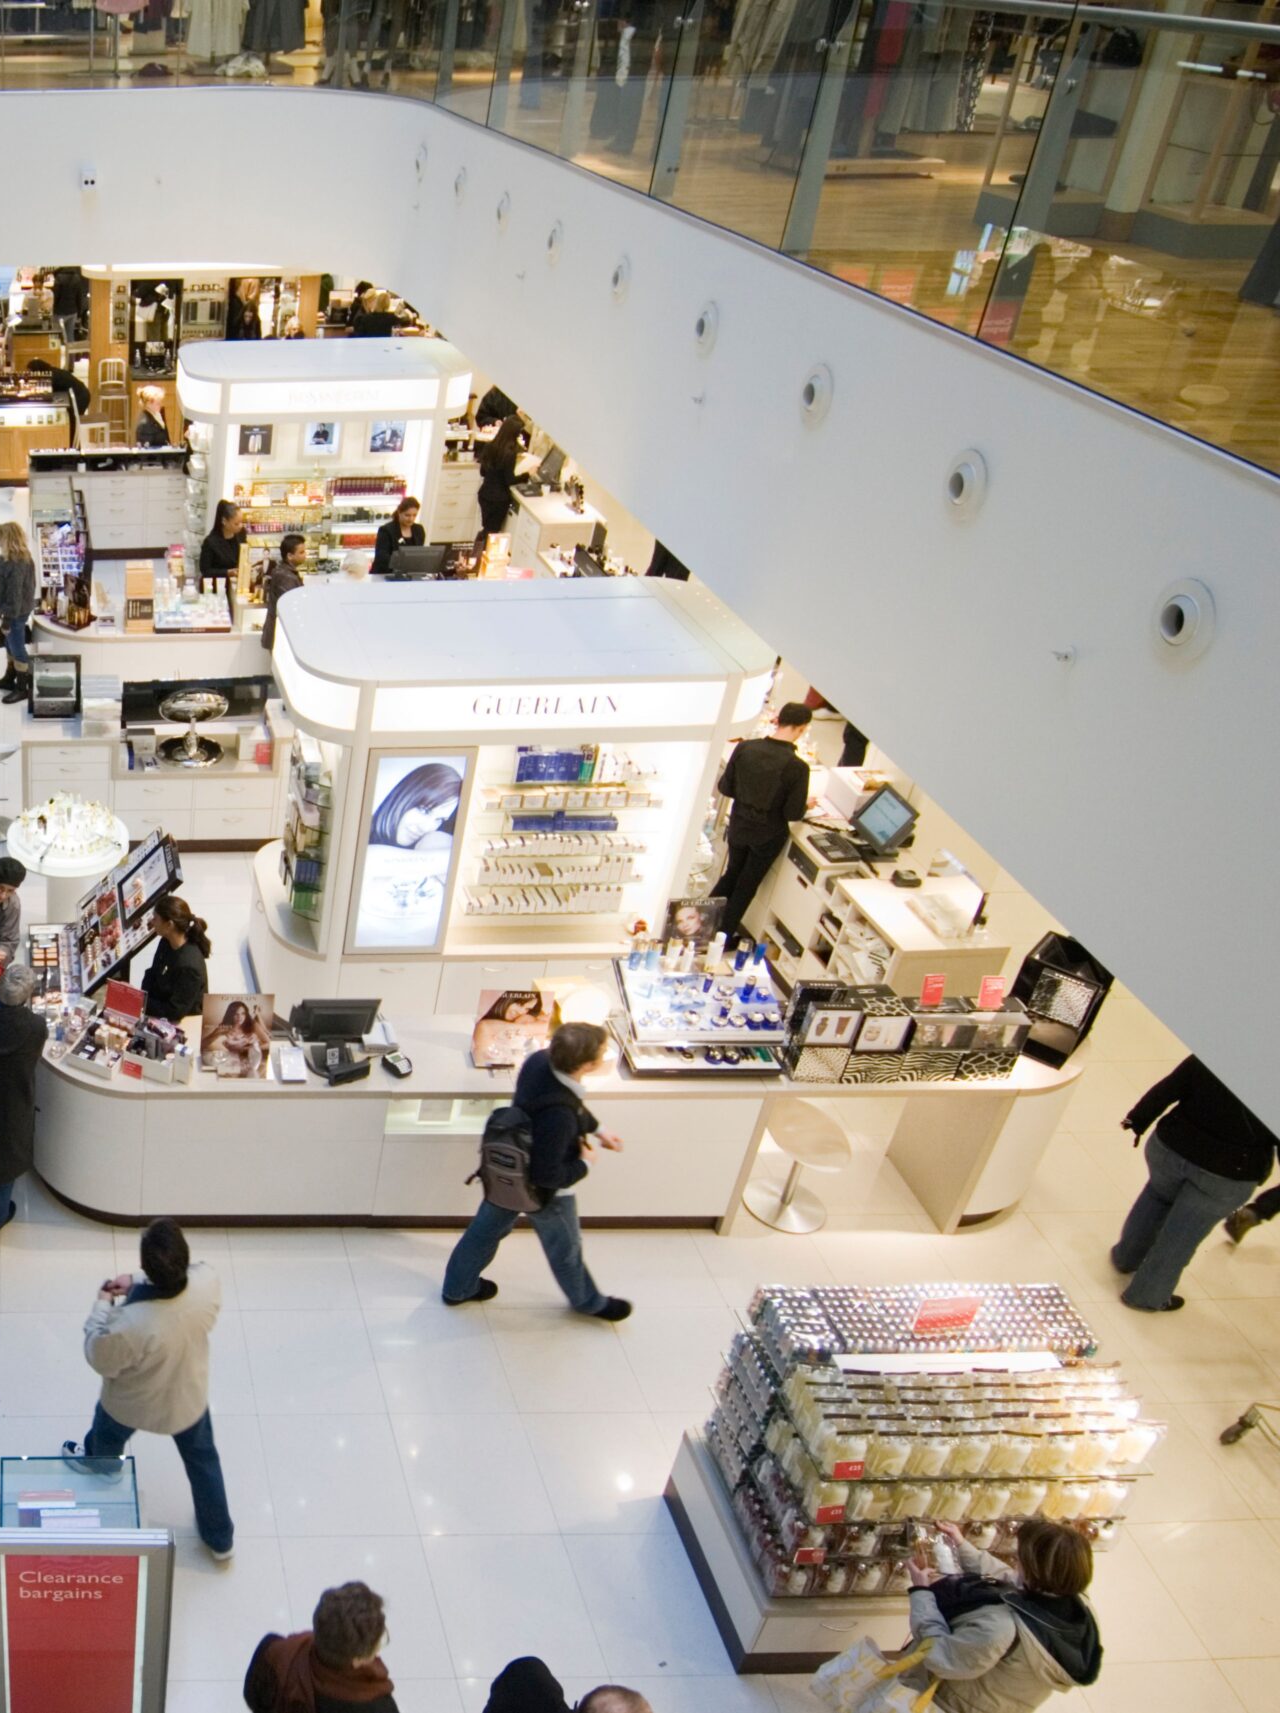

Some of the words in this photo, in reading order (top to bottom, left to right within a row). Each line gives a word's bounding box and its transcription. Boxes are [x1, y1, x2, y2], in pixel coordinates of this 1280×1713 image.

[472, 694, 621, 716] GUERLAIN
[18, 1571, 124, 1584] Clearance
[19, 1587, 103, 1602] bargains
